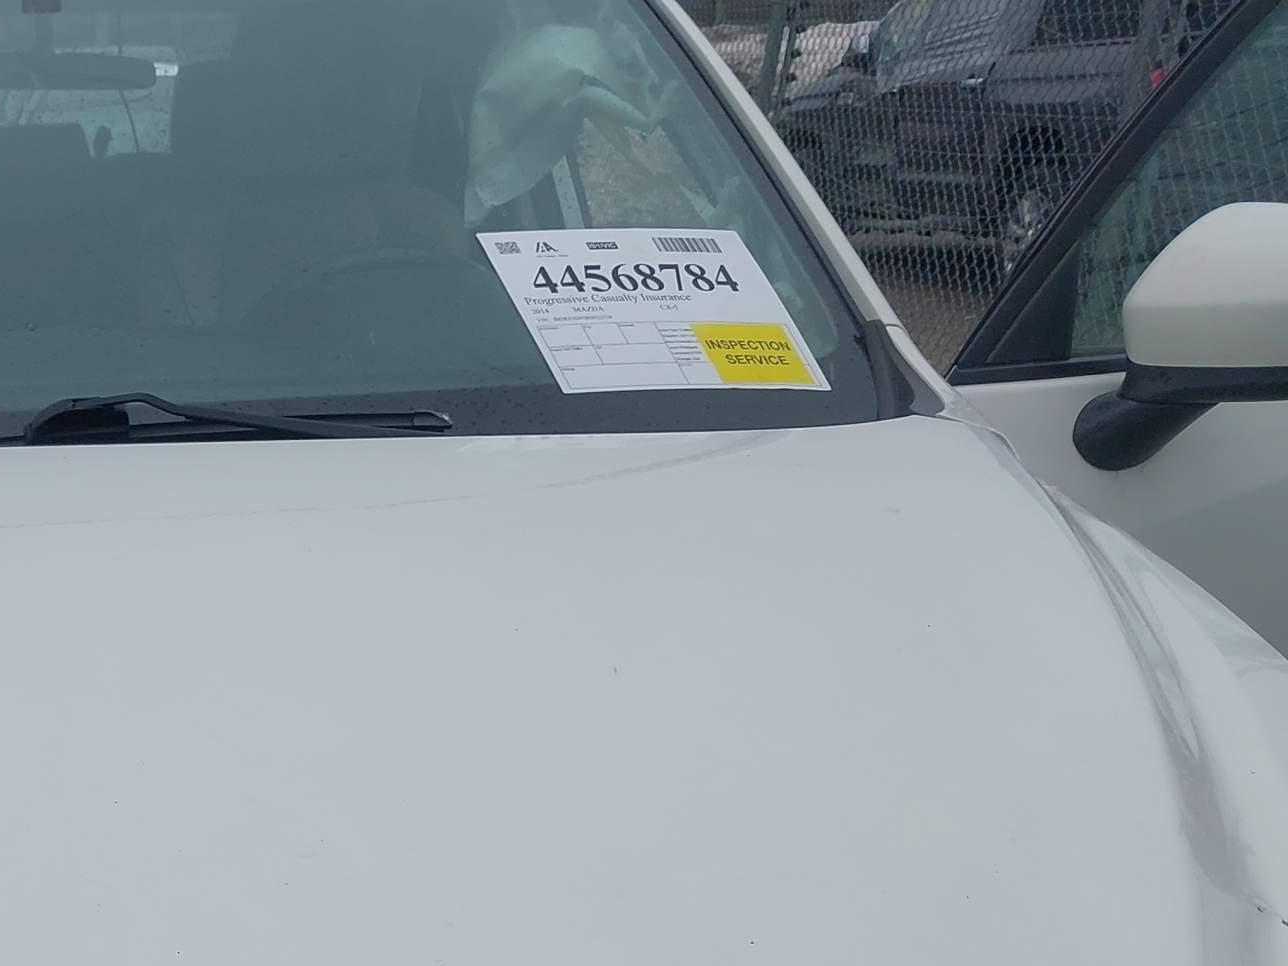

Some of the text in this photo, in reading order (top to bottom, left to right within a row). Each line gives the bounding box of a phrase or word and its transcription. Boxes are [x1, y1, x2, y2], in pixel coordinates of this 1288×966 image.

[533, 263, 739, 293] 44568784
[524, 293, 692, 306] Progressive Casualty Insurance
[705, 339, 792, 352] INSPECTION
[725, 354, 790, 365] SERVICE
